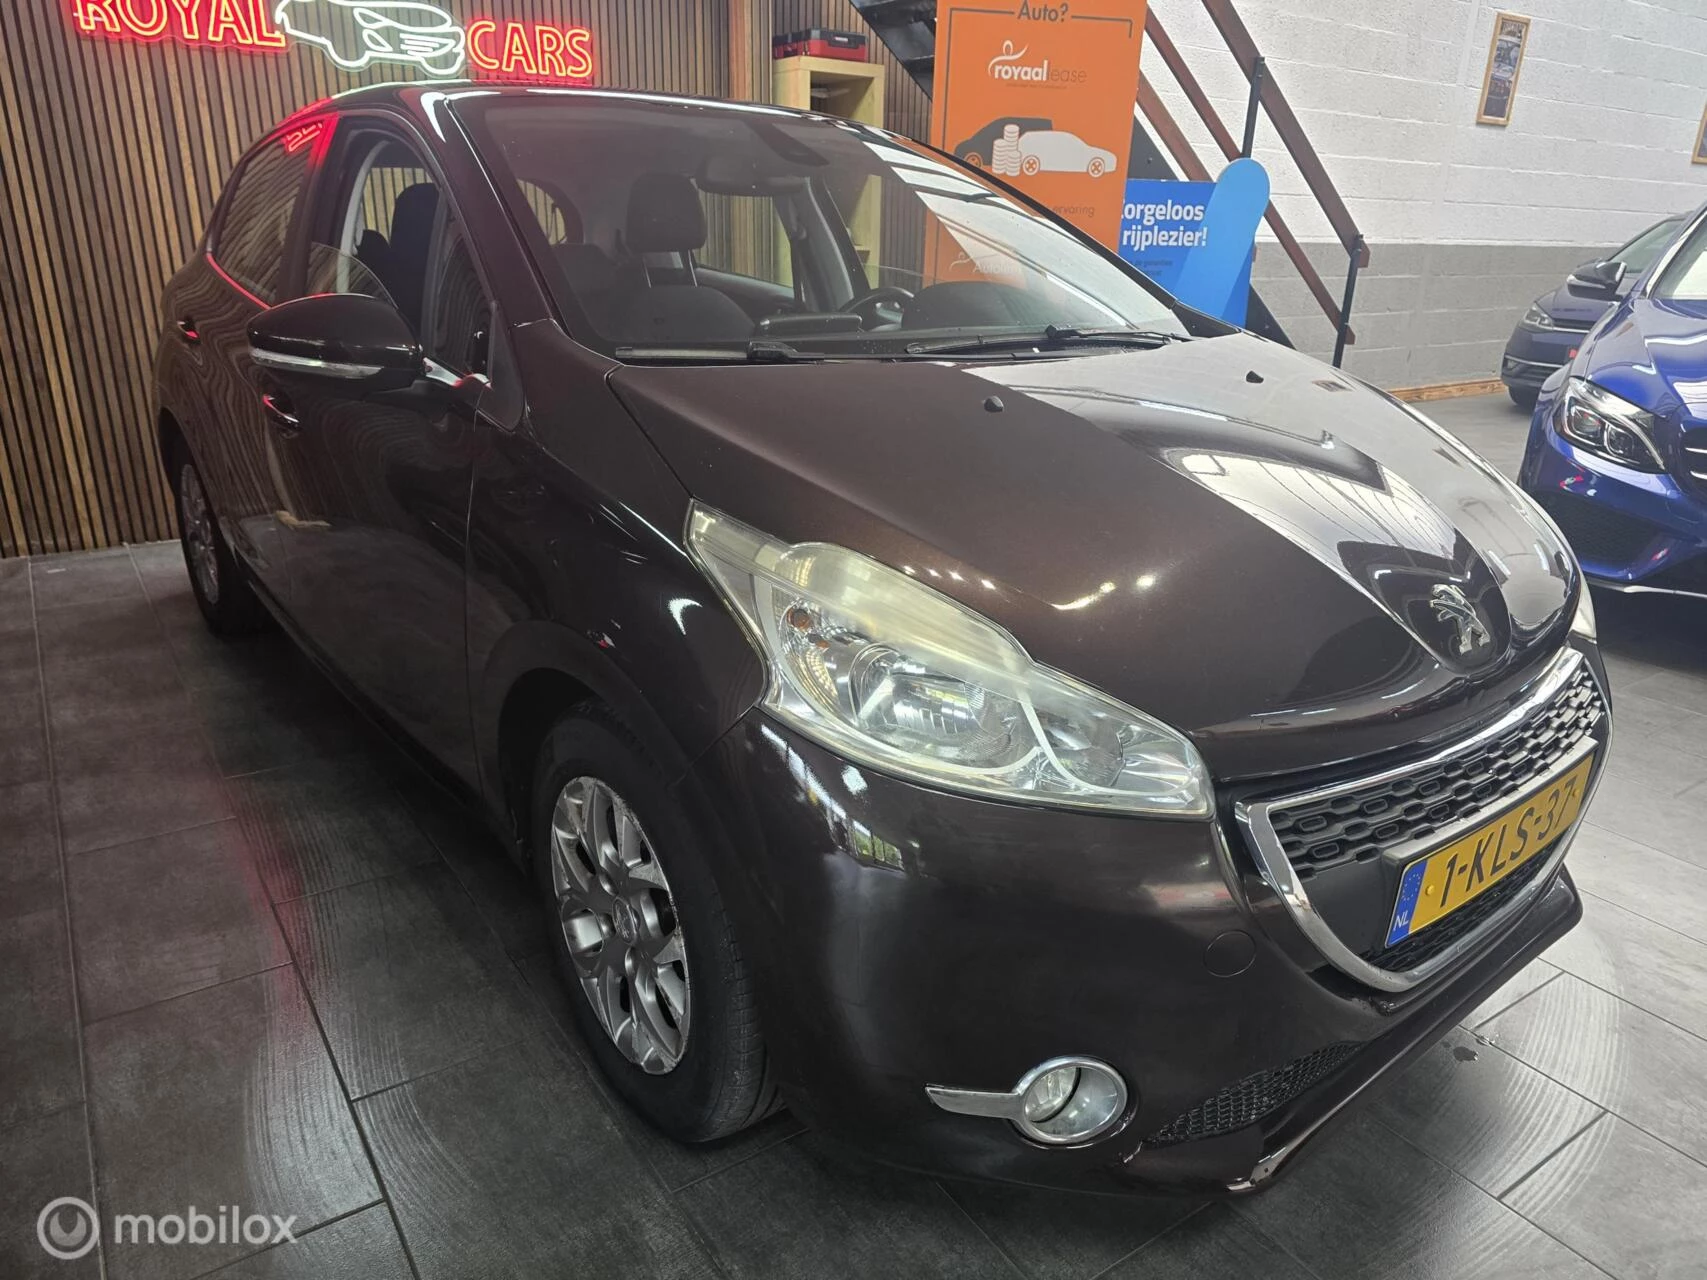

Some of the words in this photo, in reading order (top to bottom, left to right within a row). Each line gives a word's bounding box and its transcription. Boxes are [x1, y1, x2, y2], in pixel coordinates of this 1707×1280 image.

[1017, 0, 1069, 22] Auto?
[467, 21, 592, 77] CARS
[1121, 199, 1204, 226] orgeloos
[1122, 225, 1208, 251] rijplezier!
[1439, 775, 1578, 908] 1-KLS-37
[1393, 910, 1409, 931] NL
